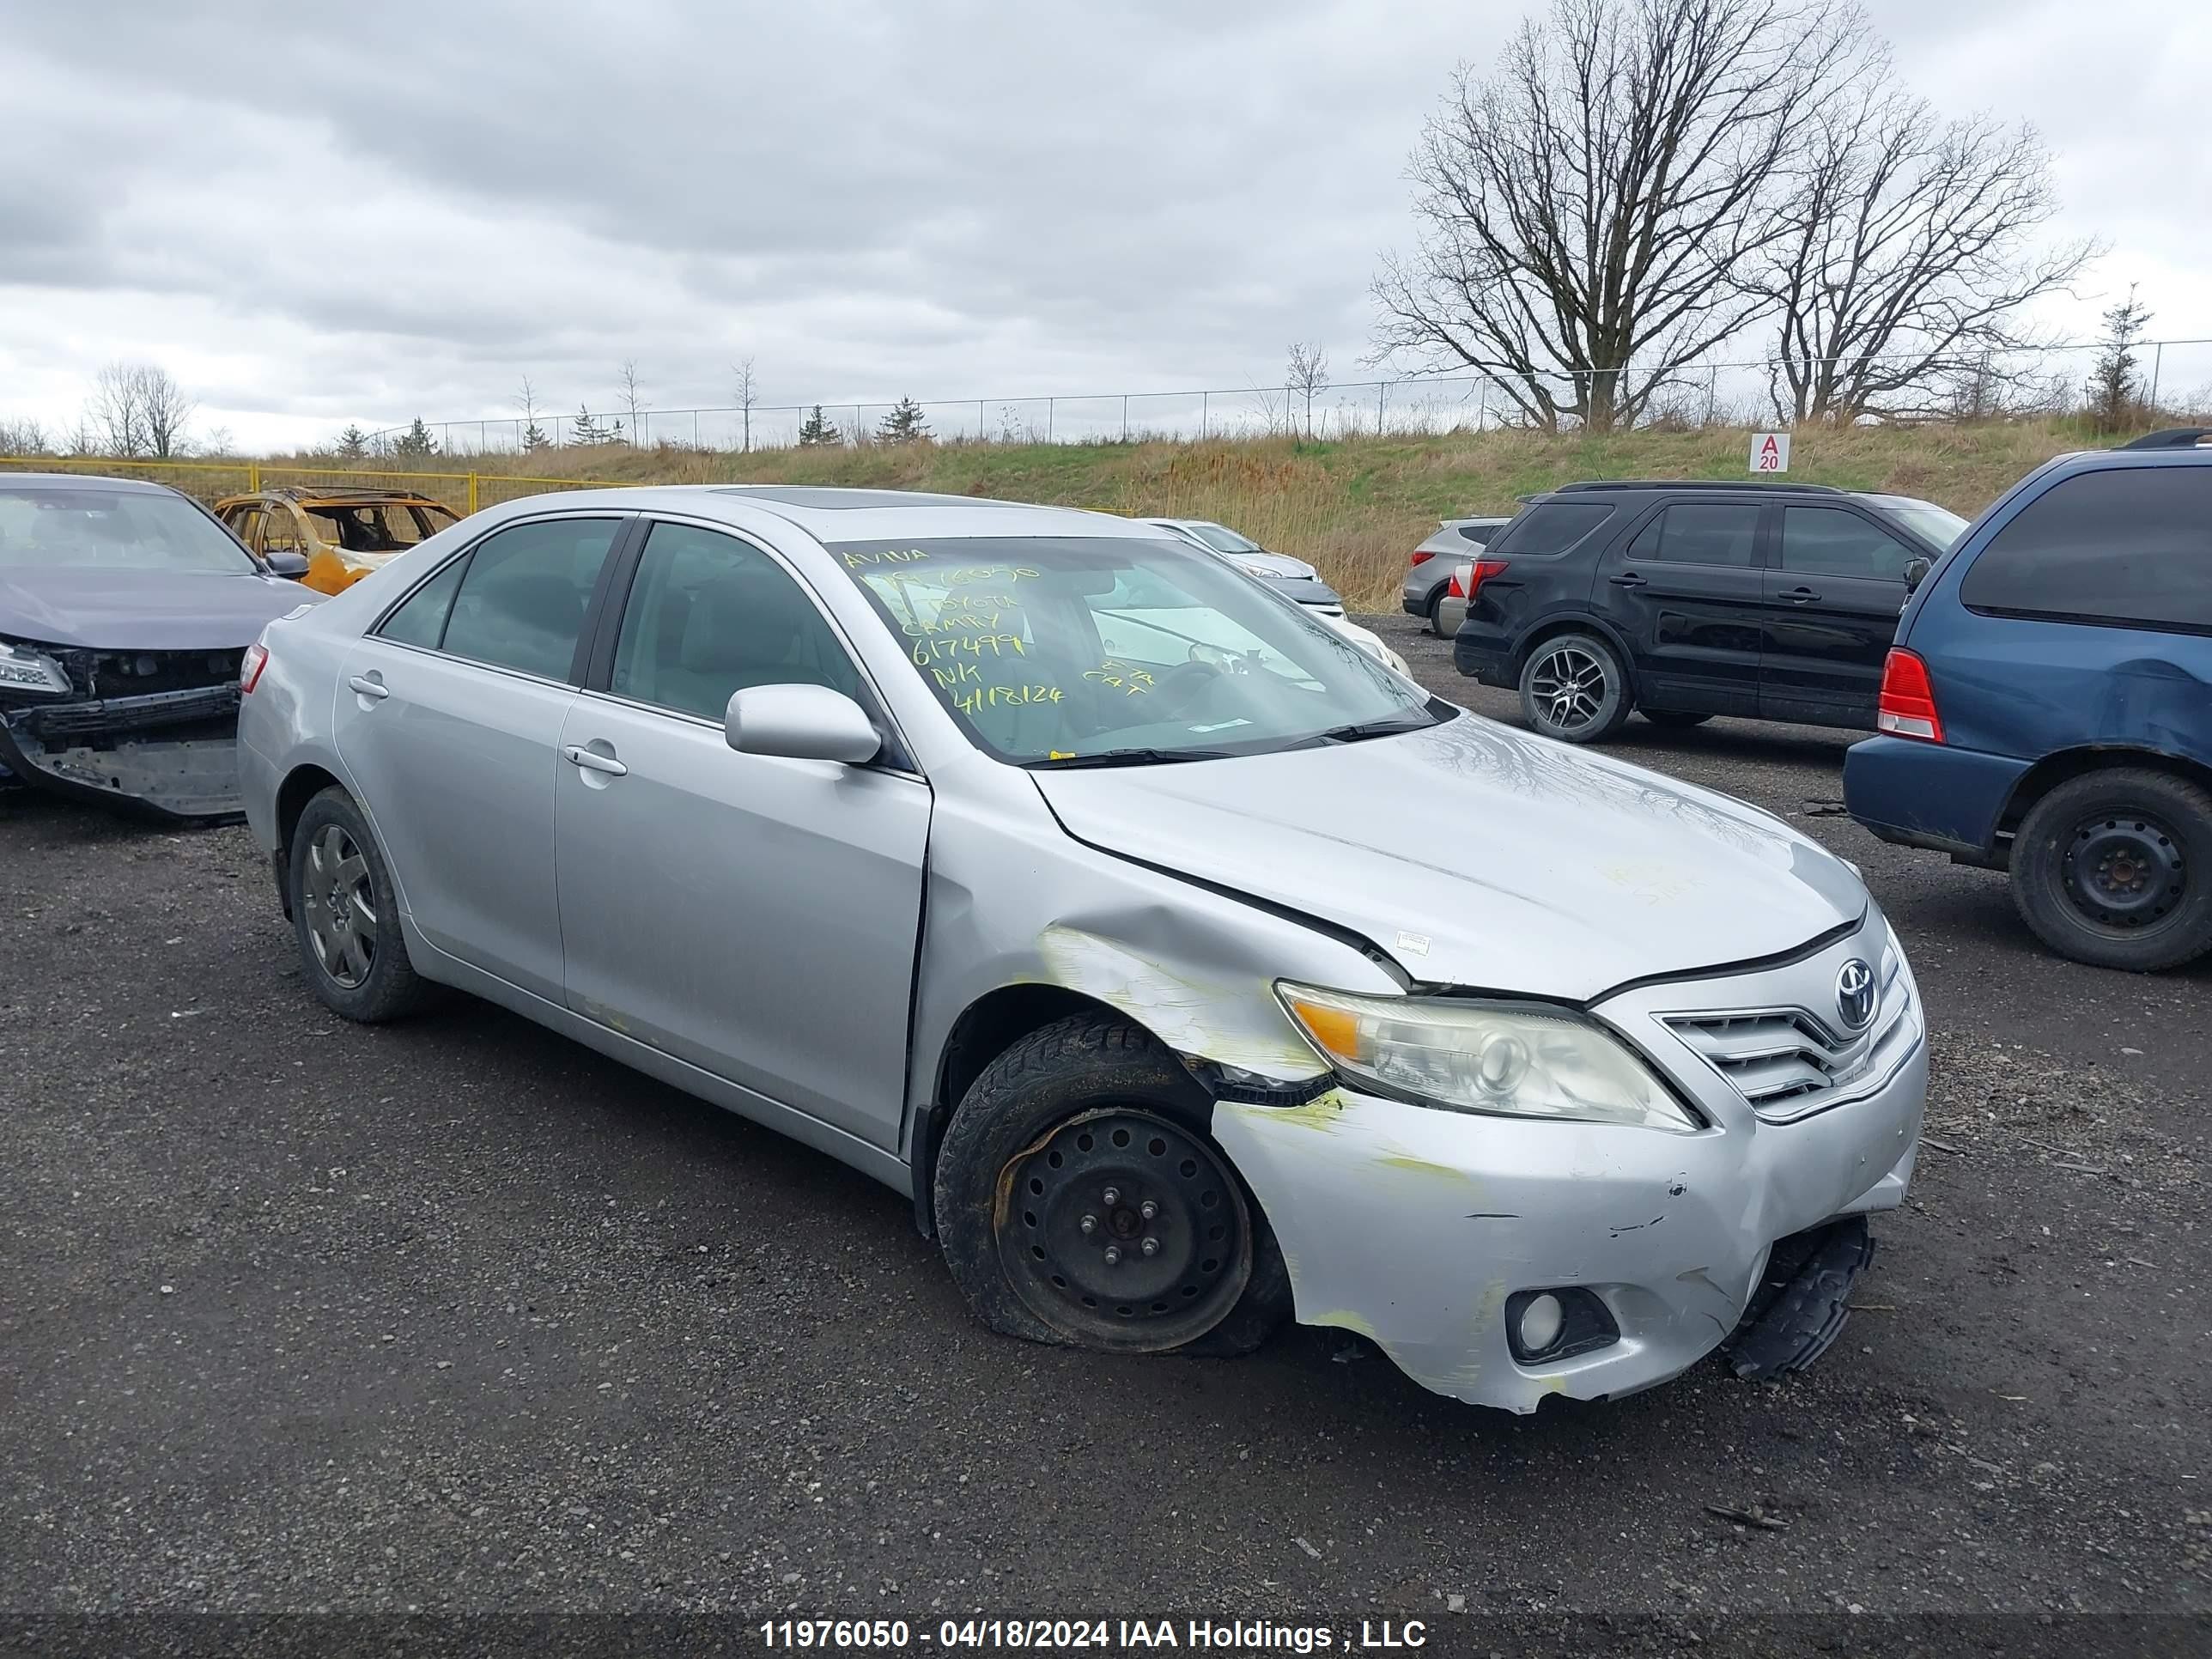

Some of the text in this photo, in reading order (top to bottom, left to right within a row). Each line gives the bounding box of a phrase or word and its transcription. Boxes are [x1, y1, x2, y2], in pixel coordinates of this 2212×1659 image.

[1761, 434, 1778, 454] A
[1759, 456, 1778, 470] 20
[842, 548, 930, 568] AVIVA
[902, 612, 1000, 636] CAMRY
[913, 634, 1025, 666] 617499
